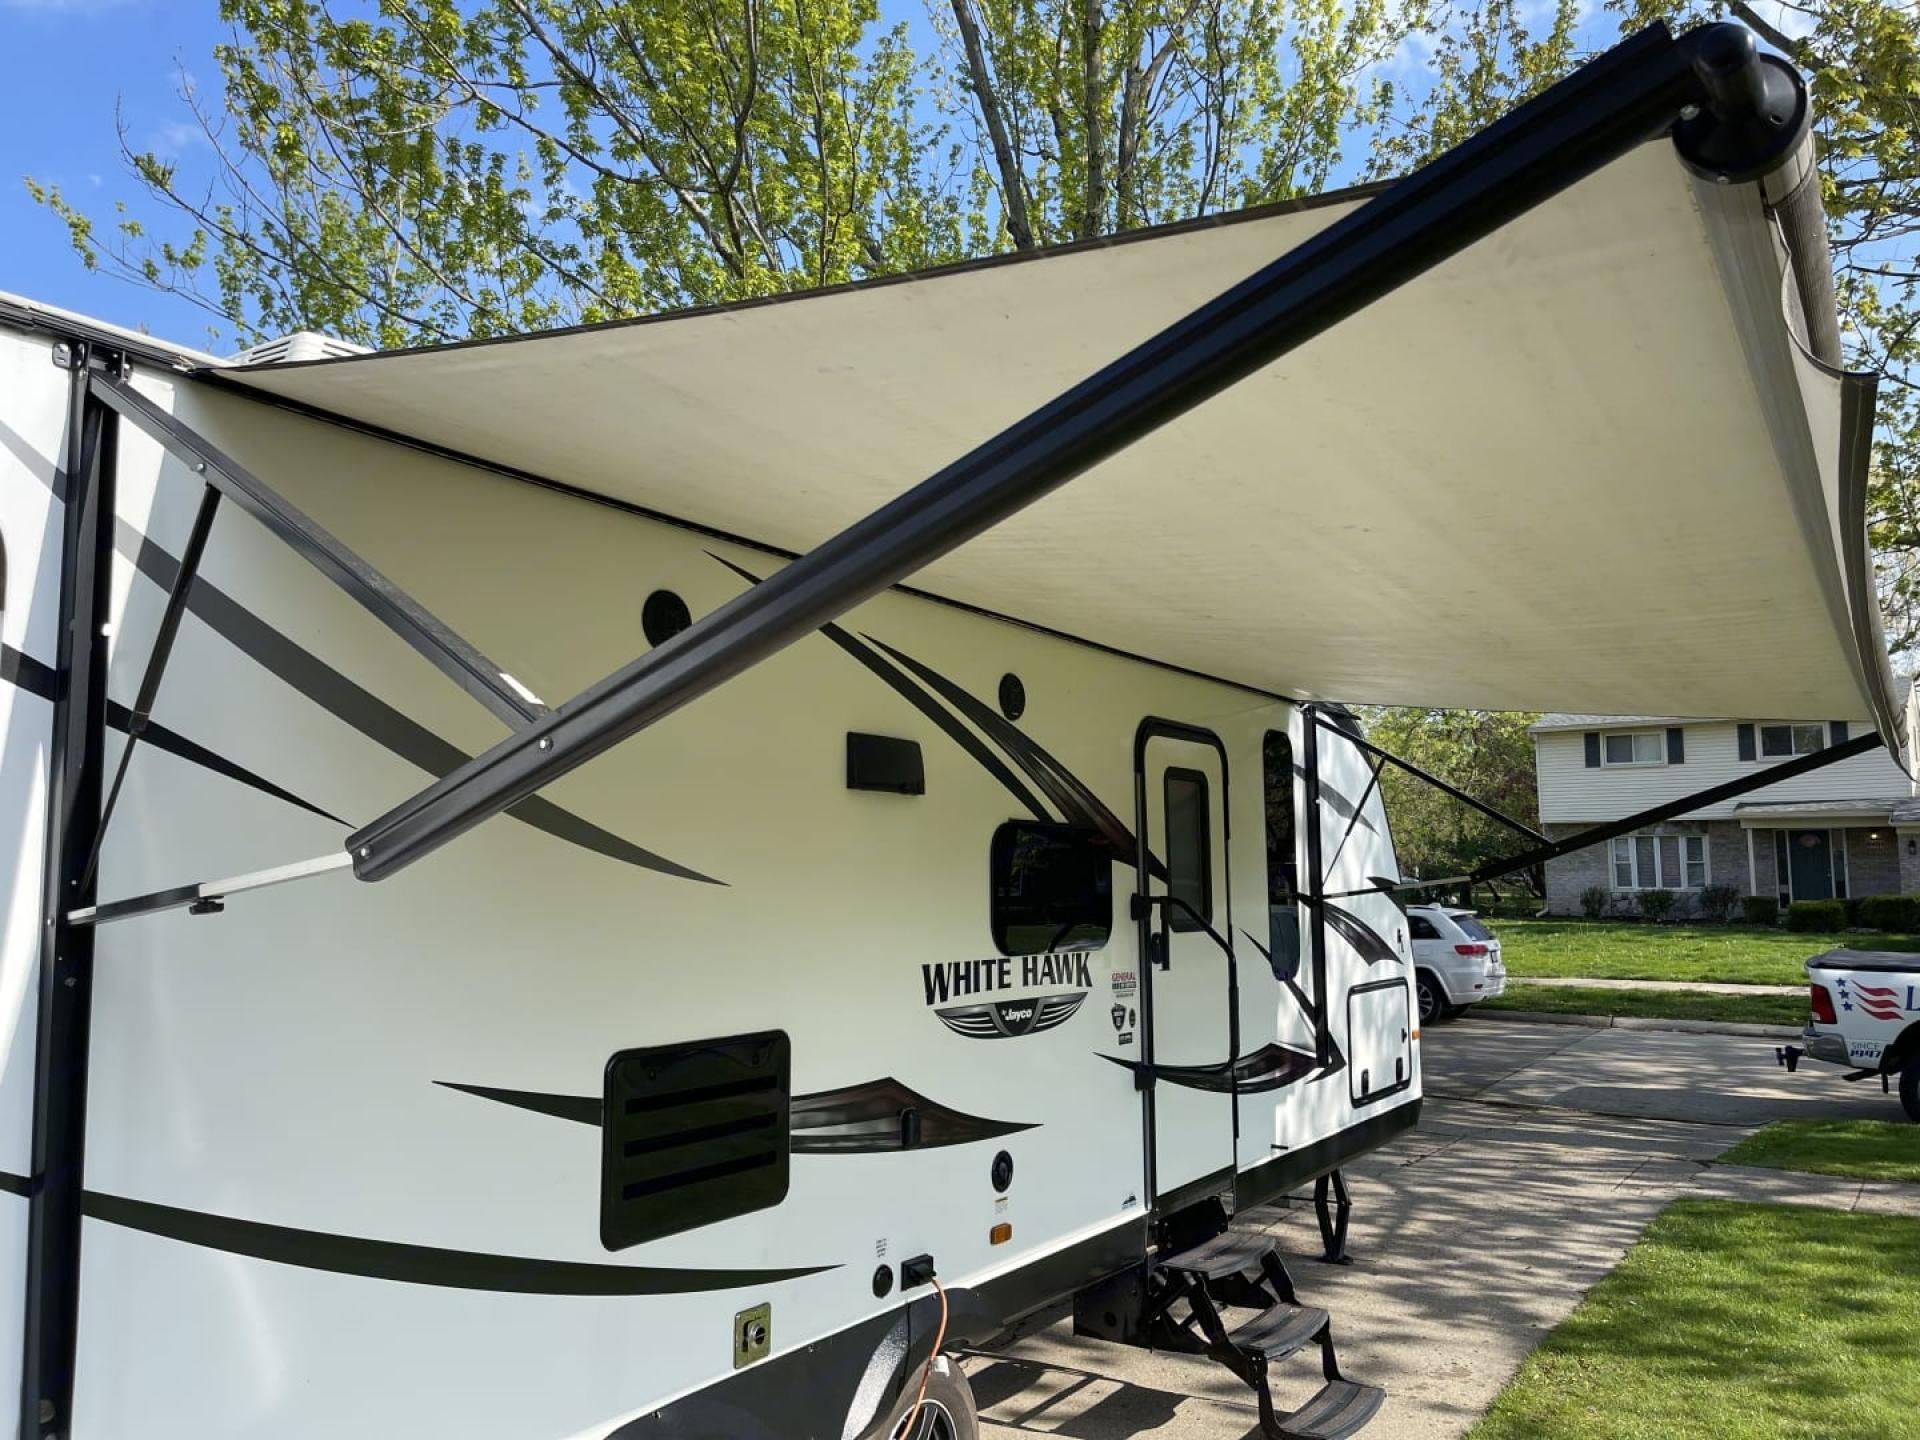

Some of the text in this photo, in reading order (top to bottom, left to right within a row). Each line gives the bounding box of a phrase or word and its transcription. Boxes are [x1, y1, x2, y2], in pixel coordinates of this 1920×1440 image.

[922, 952, 1092, 1005] WHITE HAWK
[1005, 1008, 1032, 1022] Jayco
[1851, 1041, 1880, 1050] SINCE
